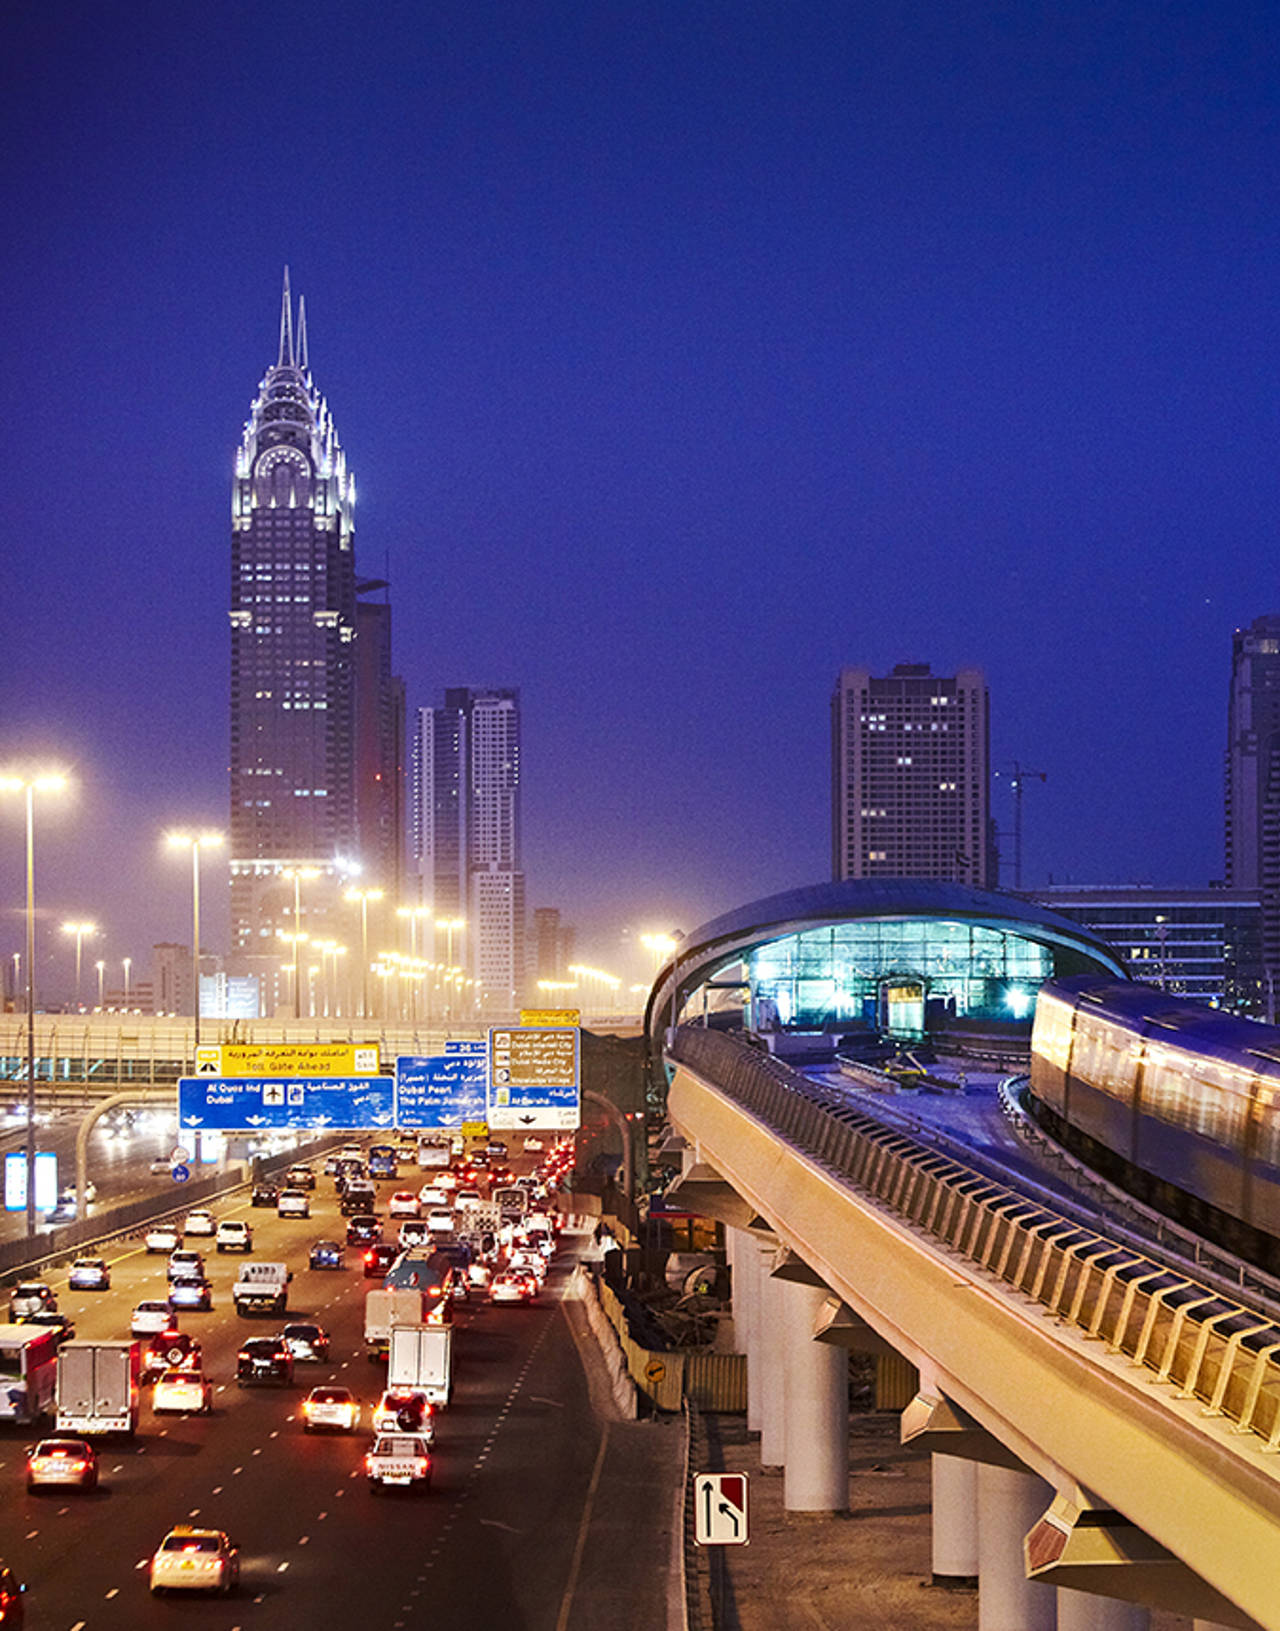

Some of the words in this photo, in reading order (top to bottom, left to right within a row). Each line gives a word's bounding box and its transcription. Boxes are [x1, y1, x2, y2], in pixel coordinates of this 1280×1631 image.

[246, 1062, 264, 1071] Toll
[269, 1062, 294, 1072] Gate
[298, 1062, 330, 1071] Ahead
[207, 1084, 217, 1093] Al
[399, 1085, 426, 1095] Dubai
[428, 1085, 452, 1095] Pearl
[206, 1095, 234, 1105] Dubai
[379, 1463, 416, 1471] NISSAN
